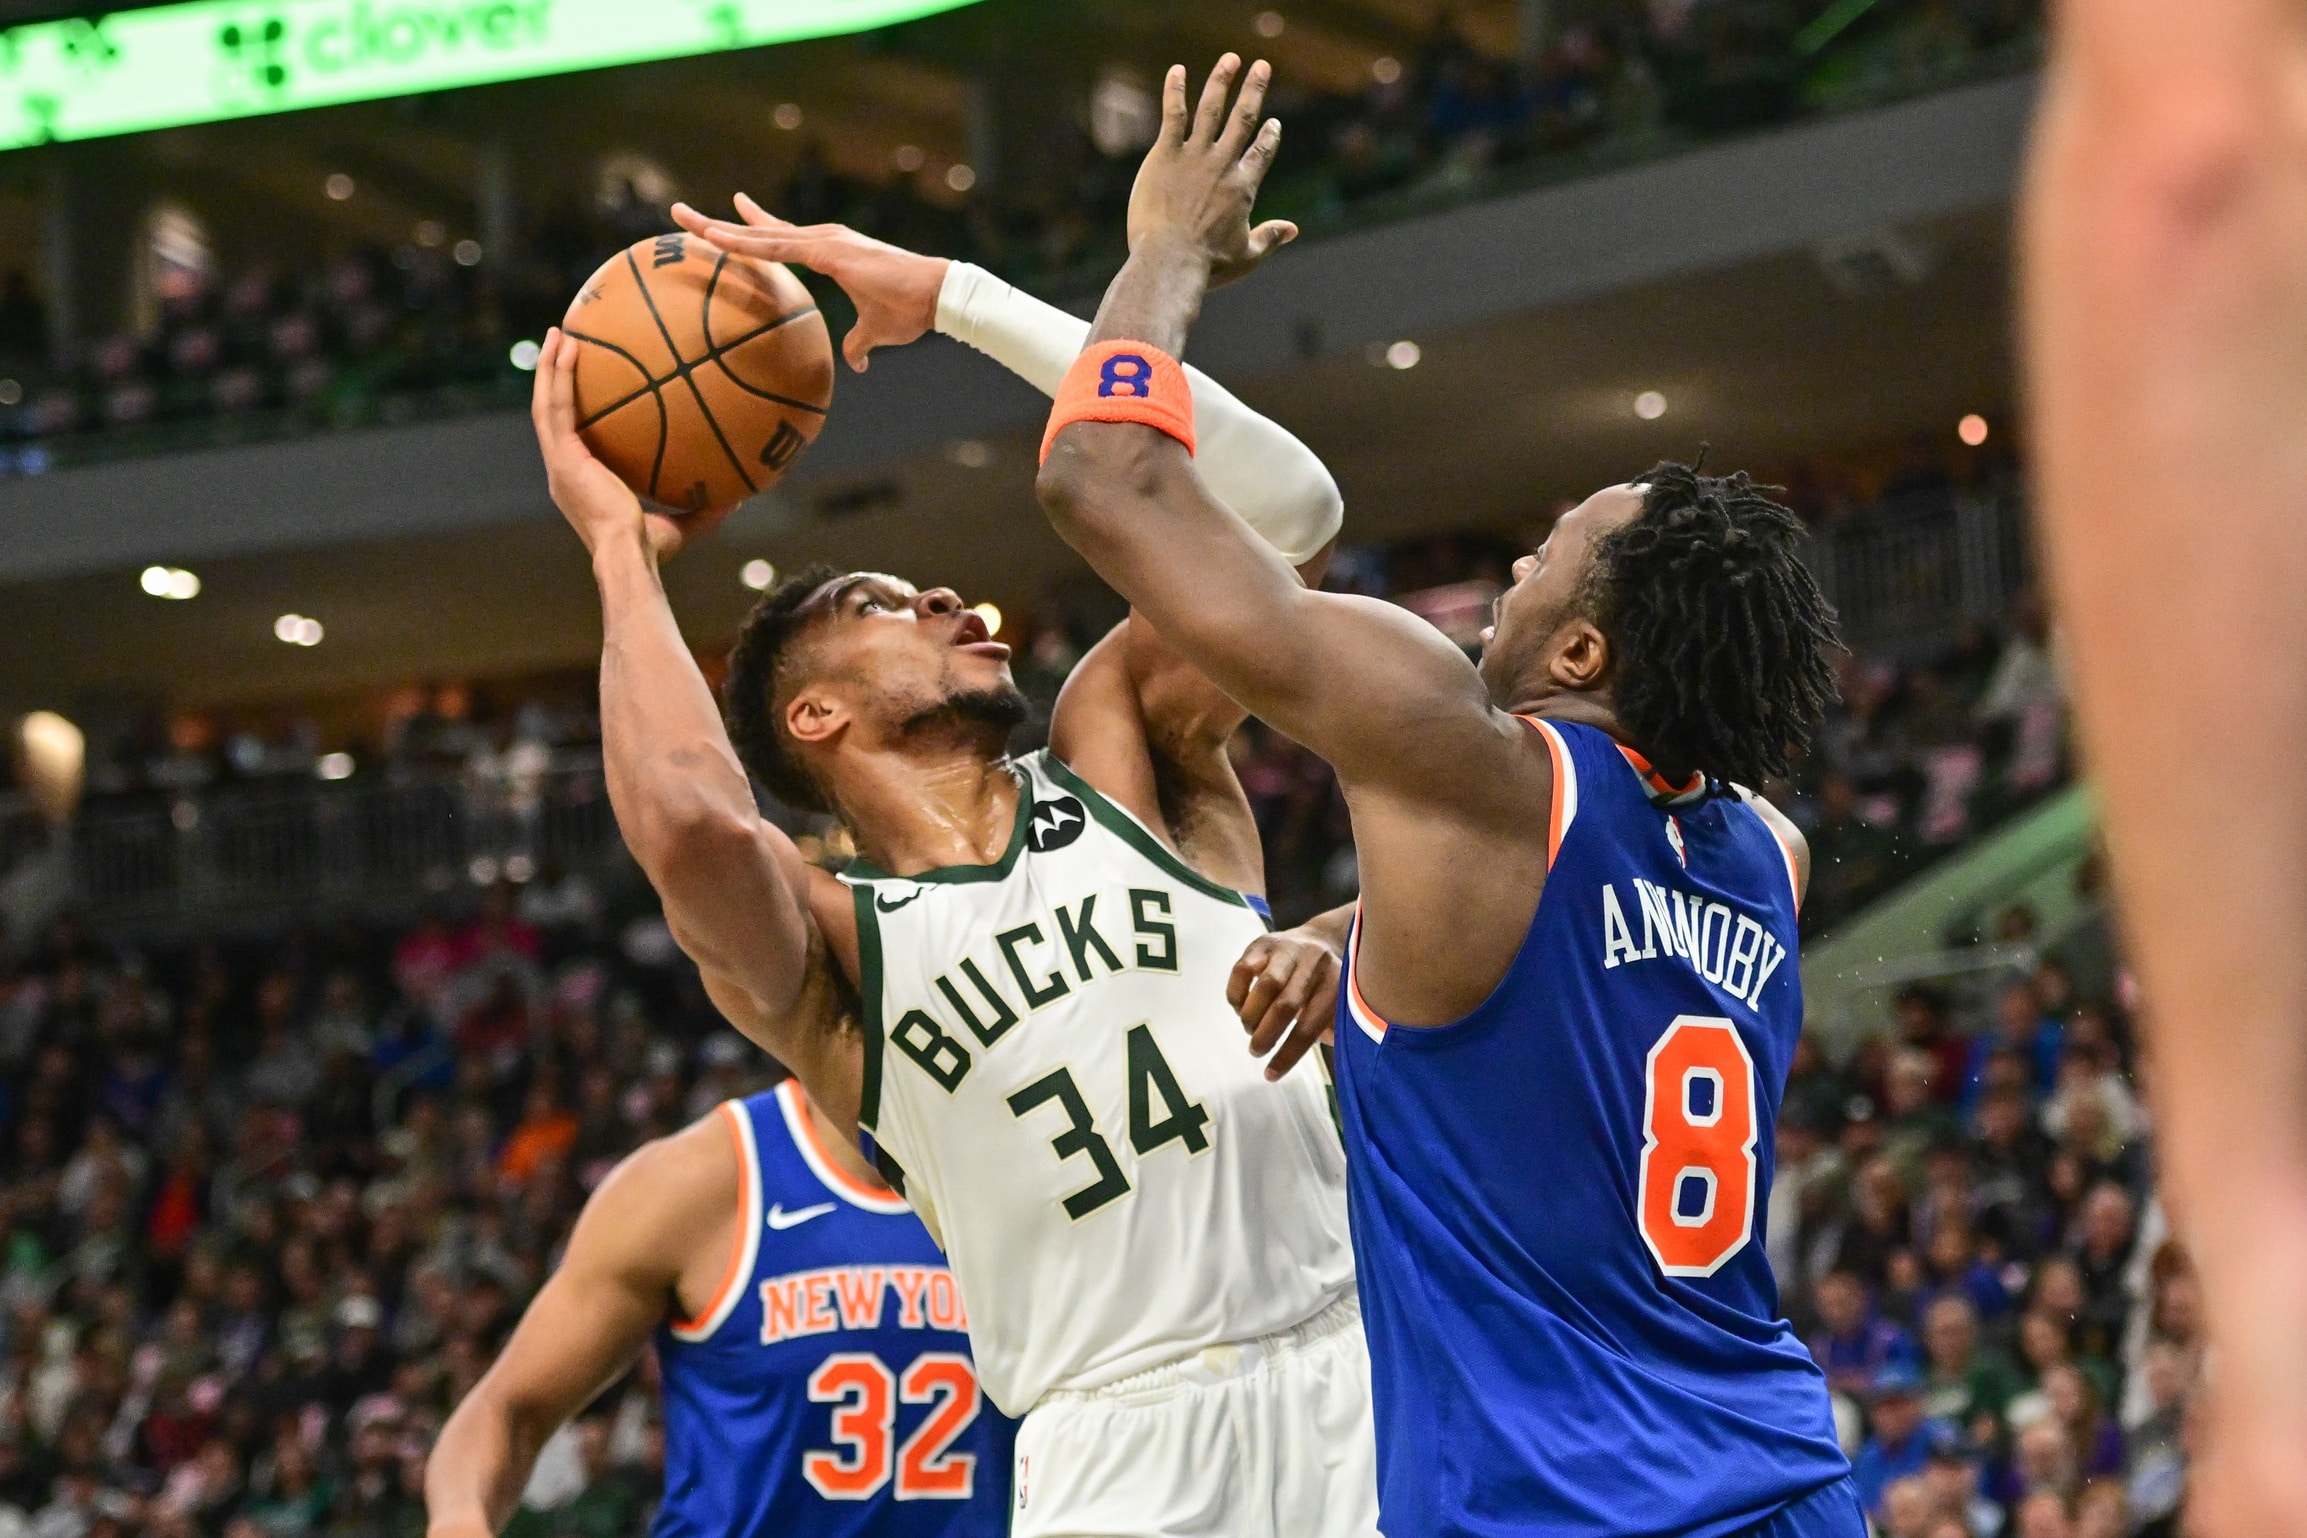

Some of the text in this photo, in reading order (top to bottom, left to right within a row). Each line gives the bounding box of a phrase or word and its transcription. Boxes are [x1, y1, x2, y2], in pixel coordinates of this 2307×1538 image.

[303, 0, 552, 75] clover
[1098, 354, 1152, 397] 8
[889, 886, 1181, 1096] BUCKS
[1004, 1020, 1215, 1222] 34
[1638, 1014, 1758, 1278] 8
[759, 1266, 885, 1345] NEW
[803, 1352, 982, 1501] 32
